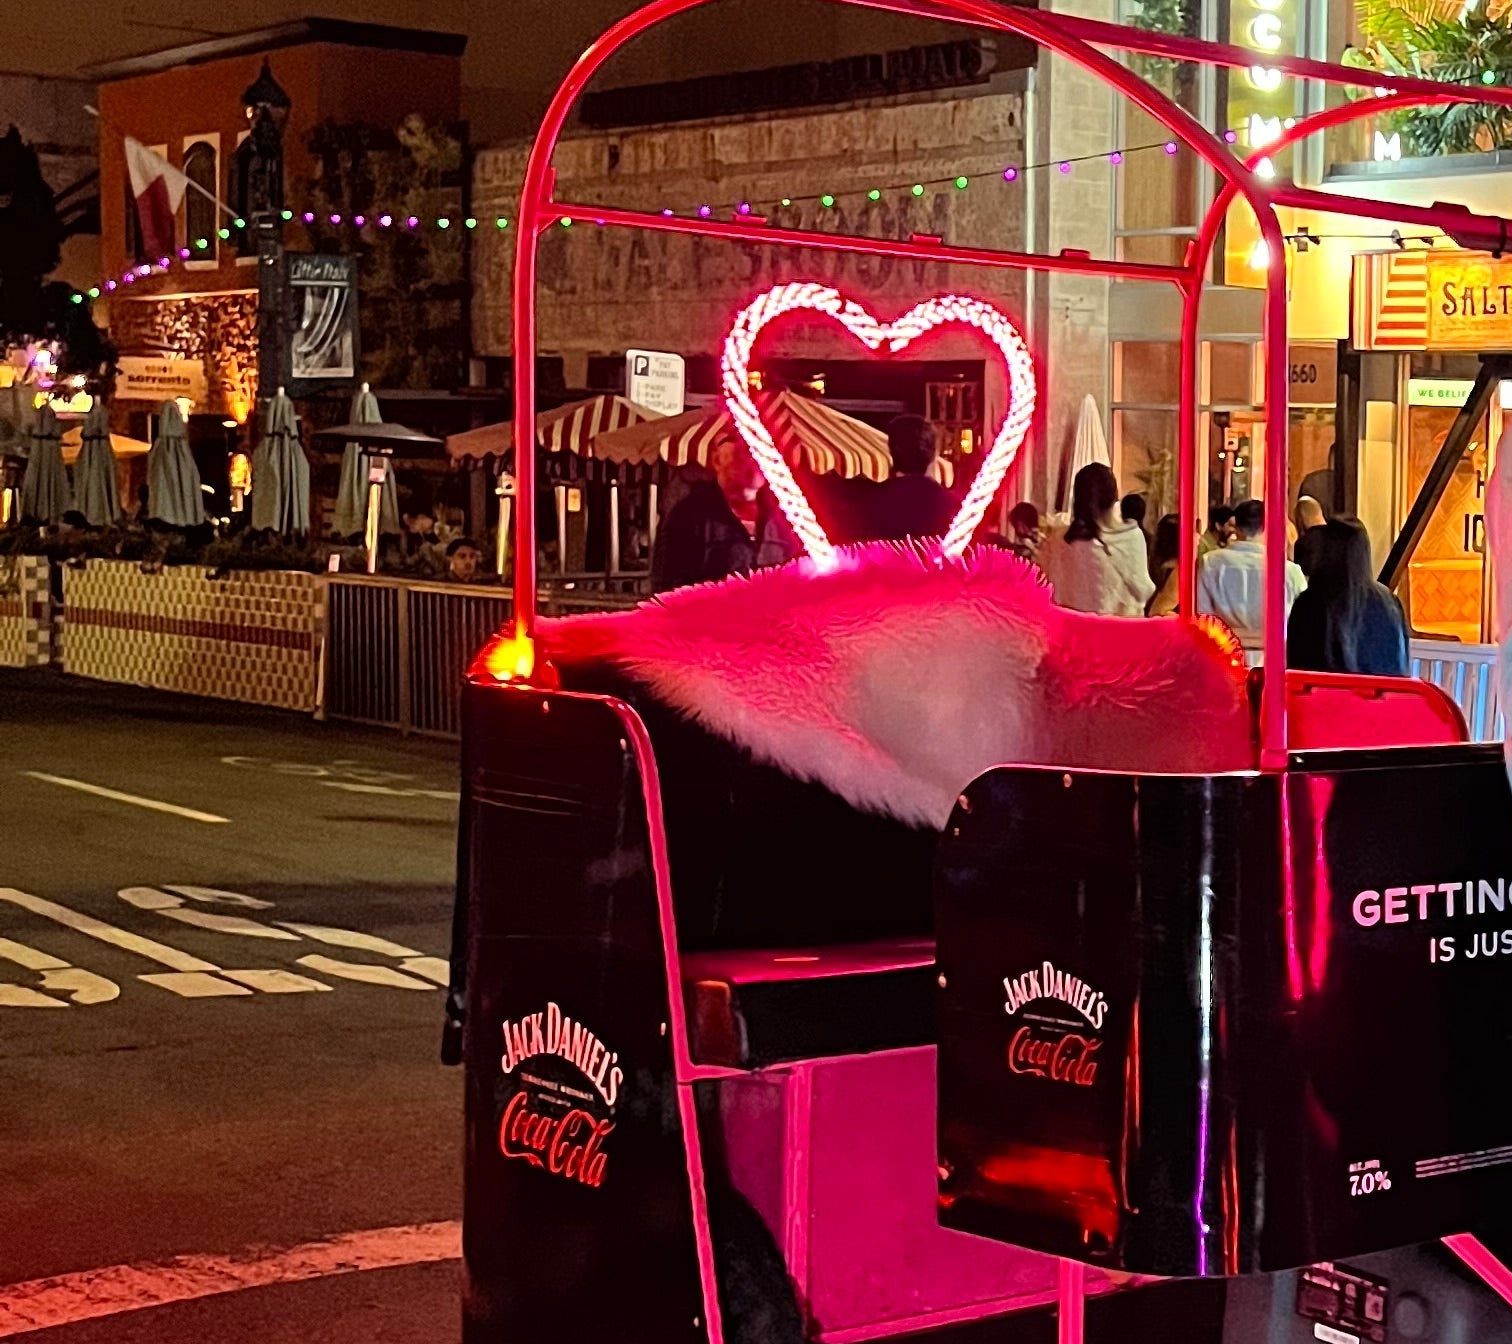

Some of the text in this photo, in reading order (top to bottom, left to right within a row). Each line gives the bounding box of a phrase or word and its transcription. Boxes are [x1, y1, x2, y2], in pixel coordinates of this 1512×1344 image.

[1442, 282, 1512, 316] SALT
[1417, 389, 1434, 398] WE
[1430, 937, 1456, 963] IS
[1003, 960, 1109, 1029] JACK DANIEL'S
[502, 1001, 624, 1106] JACK DANIEL'S
[1349, 1170, 1392, 1197] 7.0%
